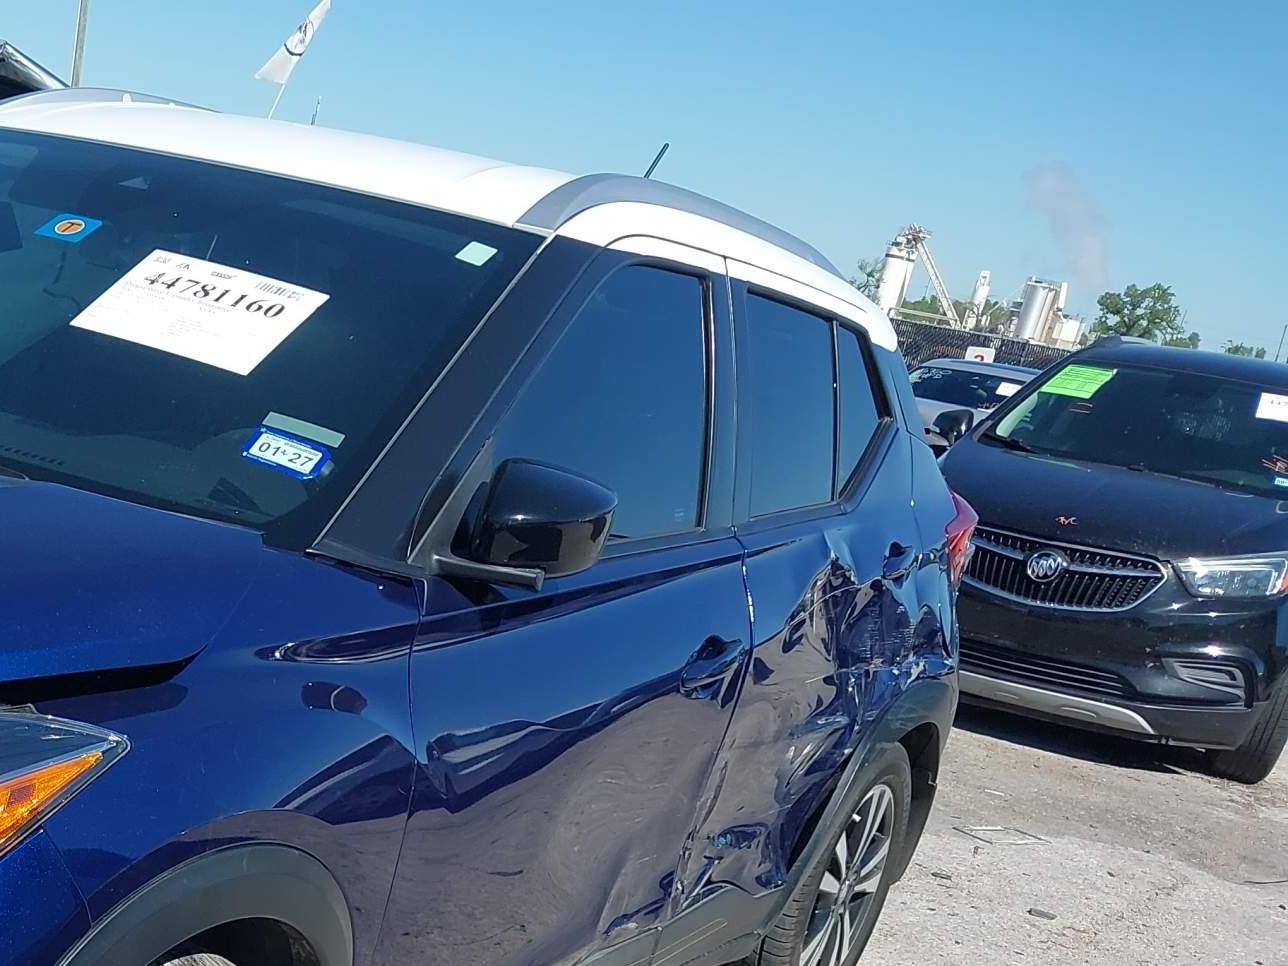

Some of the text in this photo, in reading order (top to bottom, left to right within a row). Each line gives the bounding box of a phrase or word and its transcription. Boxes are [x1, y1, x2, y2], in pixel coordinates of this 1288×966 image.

[144, 272, 286, 319] 44781160
[258, 441, 281, 457] 01
[288, 452, 314, 467] 27
